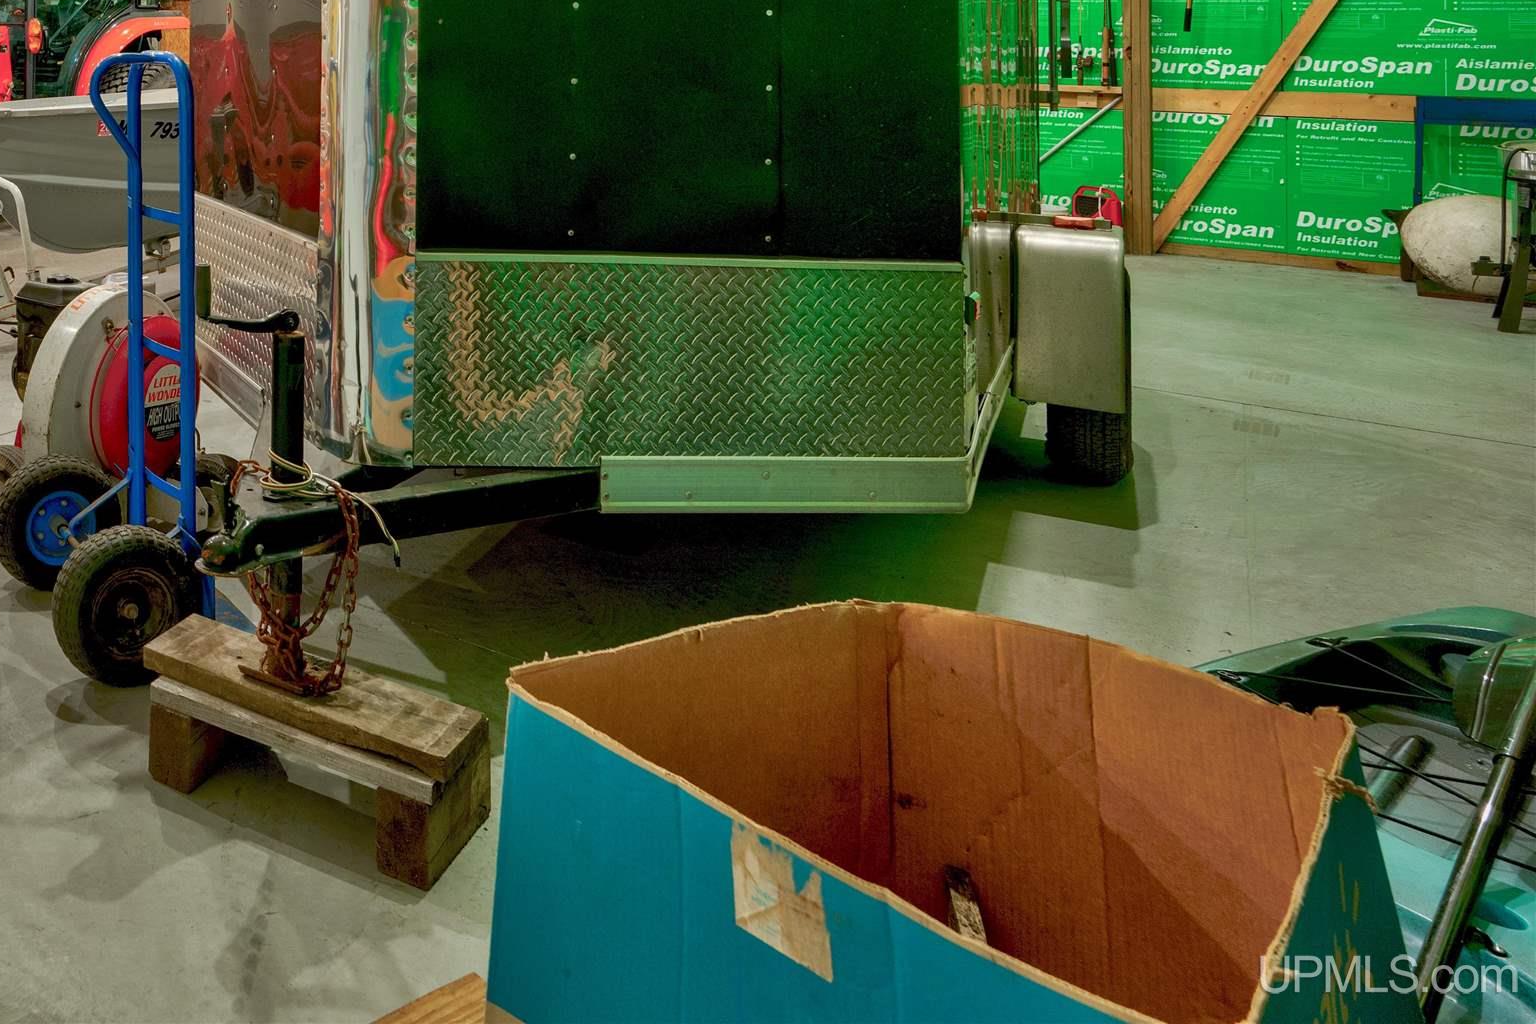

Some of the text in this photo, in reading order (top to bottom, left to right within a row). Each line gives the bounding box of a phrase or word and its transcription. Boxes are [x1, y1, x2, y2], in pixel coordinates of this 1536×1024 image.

[1396, 42, 1497, 51] www.plastifab.com
[1294, 56, 1433, 78] DuroSpan
[1294, 76, 1374, 89] Insulation
[1296, 119, 1377, 133] Insulation
[1296, 231, 1378, 248] Insulation
[153, 375, 181, 388] LITTL
[148, 389, 181, 403] WONDE
